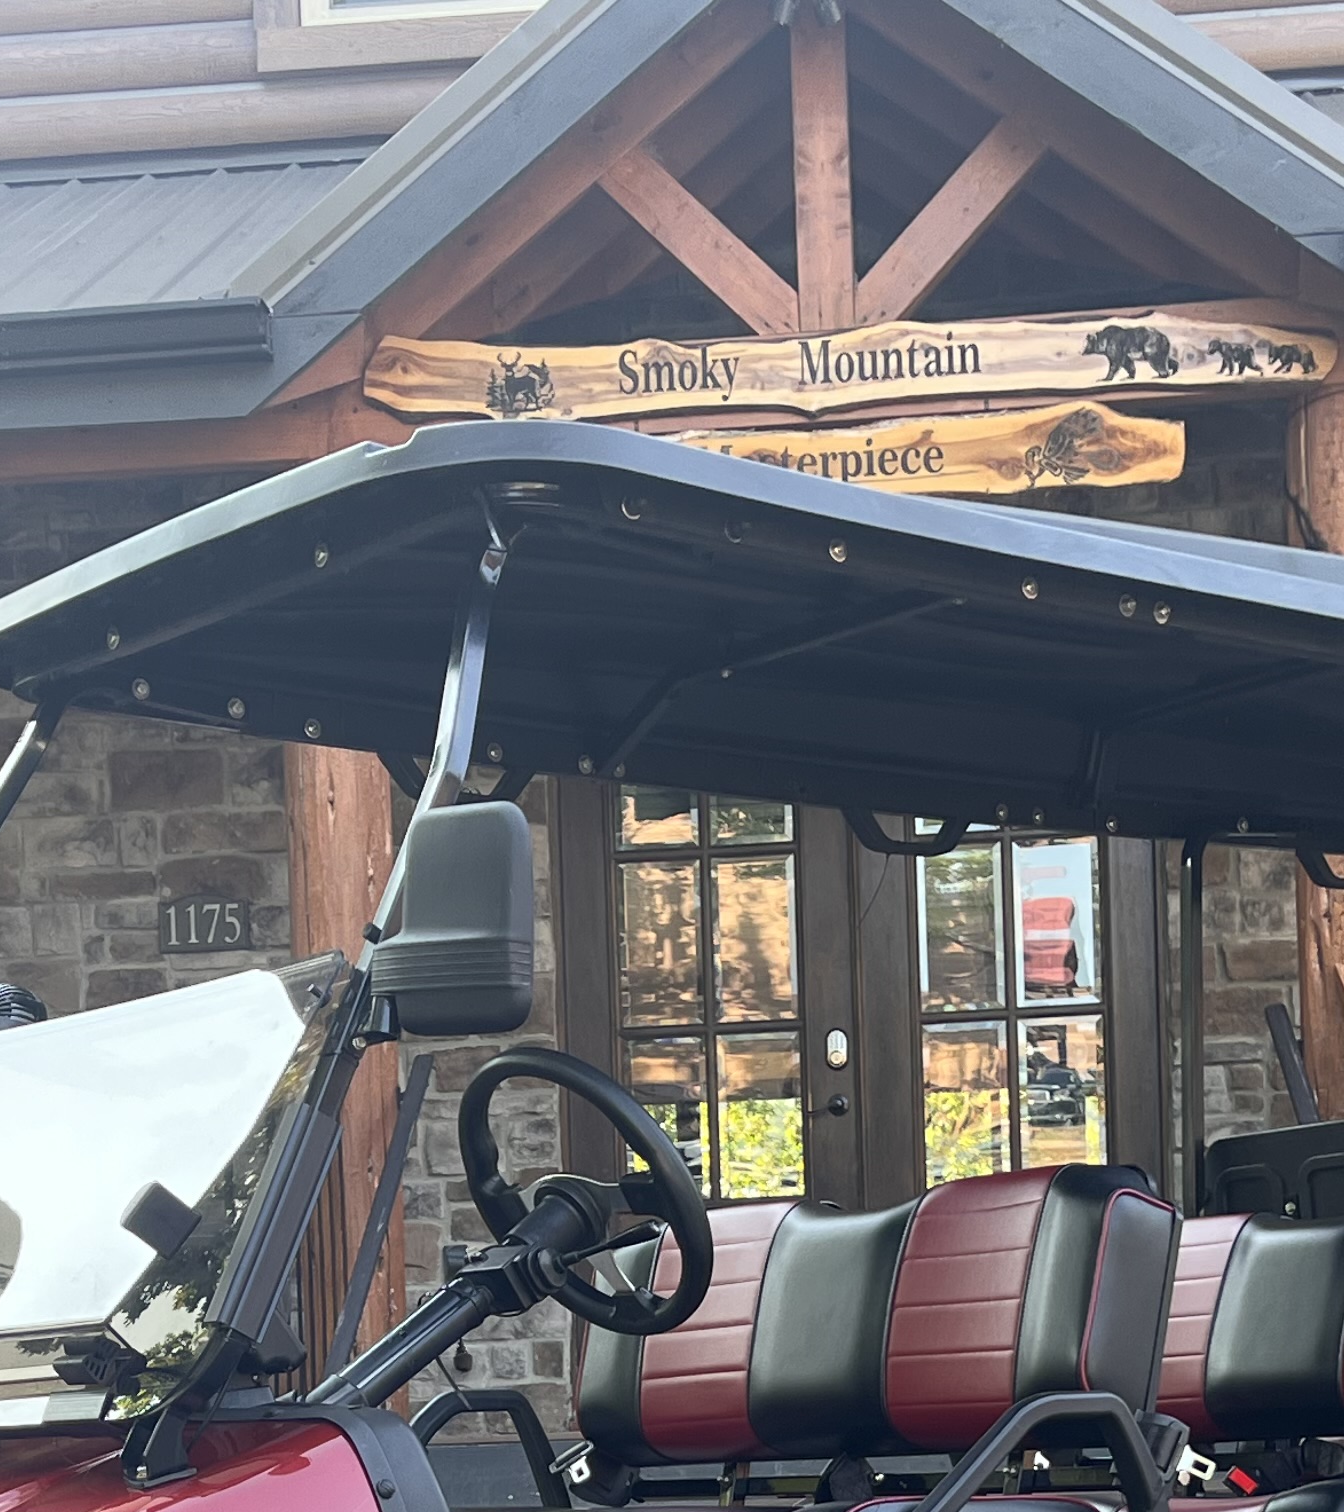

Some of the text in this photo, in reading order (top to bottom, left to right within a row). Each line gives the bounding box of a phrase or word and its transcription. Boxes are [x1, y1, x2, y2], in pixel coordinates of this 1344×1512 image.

[618, 331, 982, 402] Smoky Mountain
[705, 438, 944, 482] terpiece
[165, 903, 241, 945] 1175
